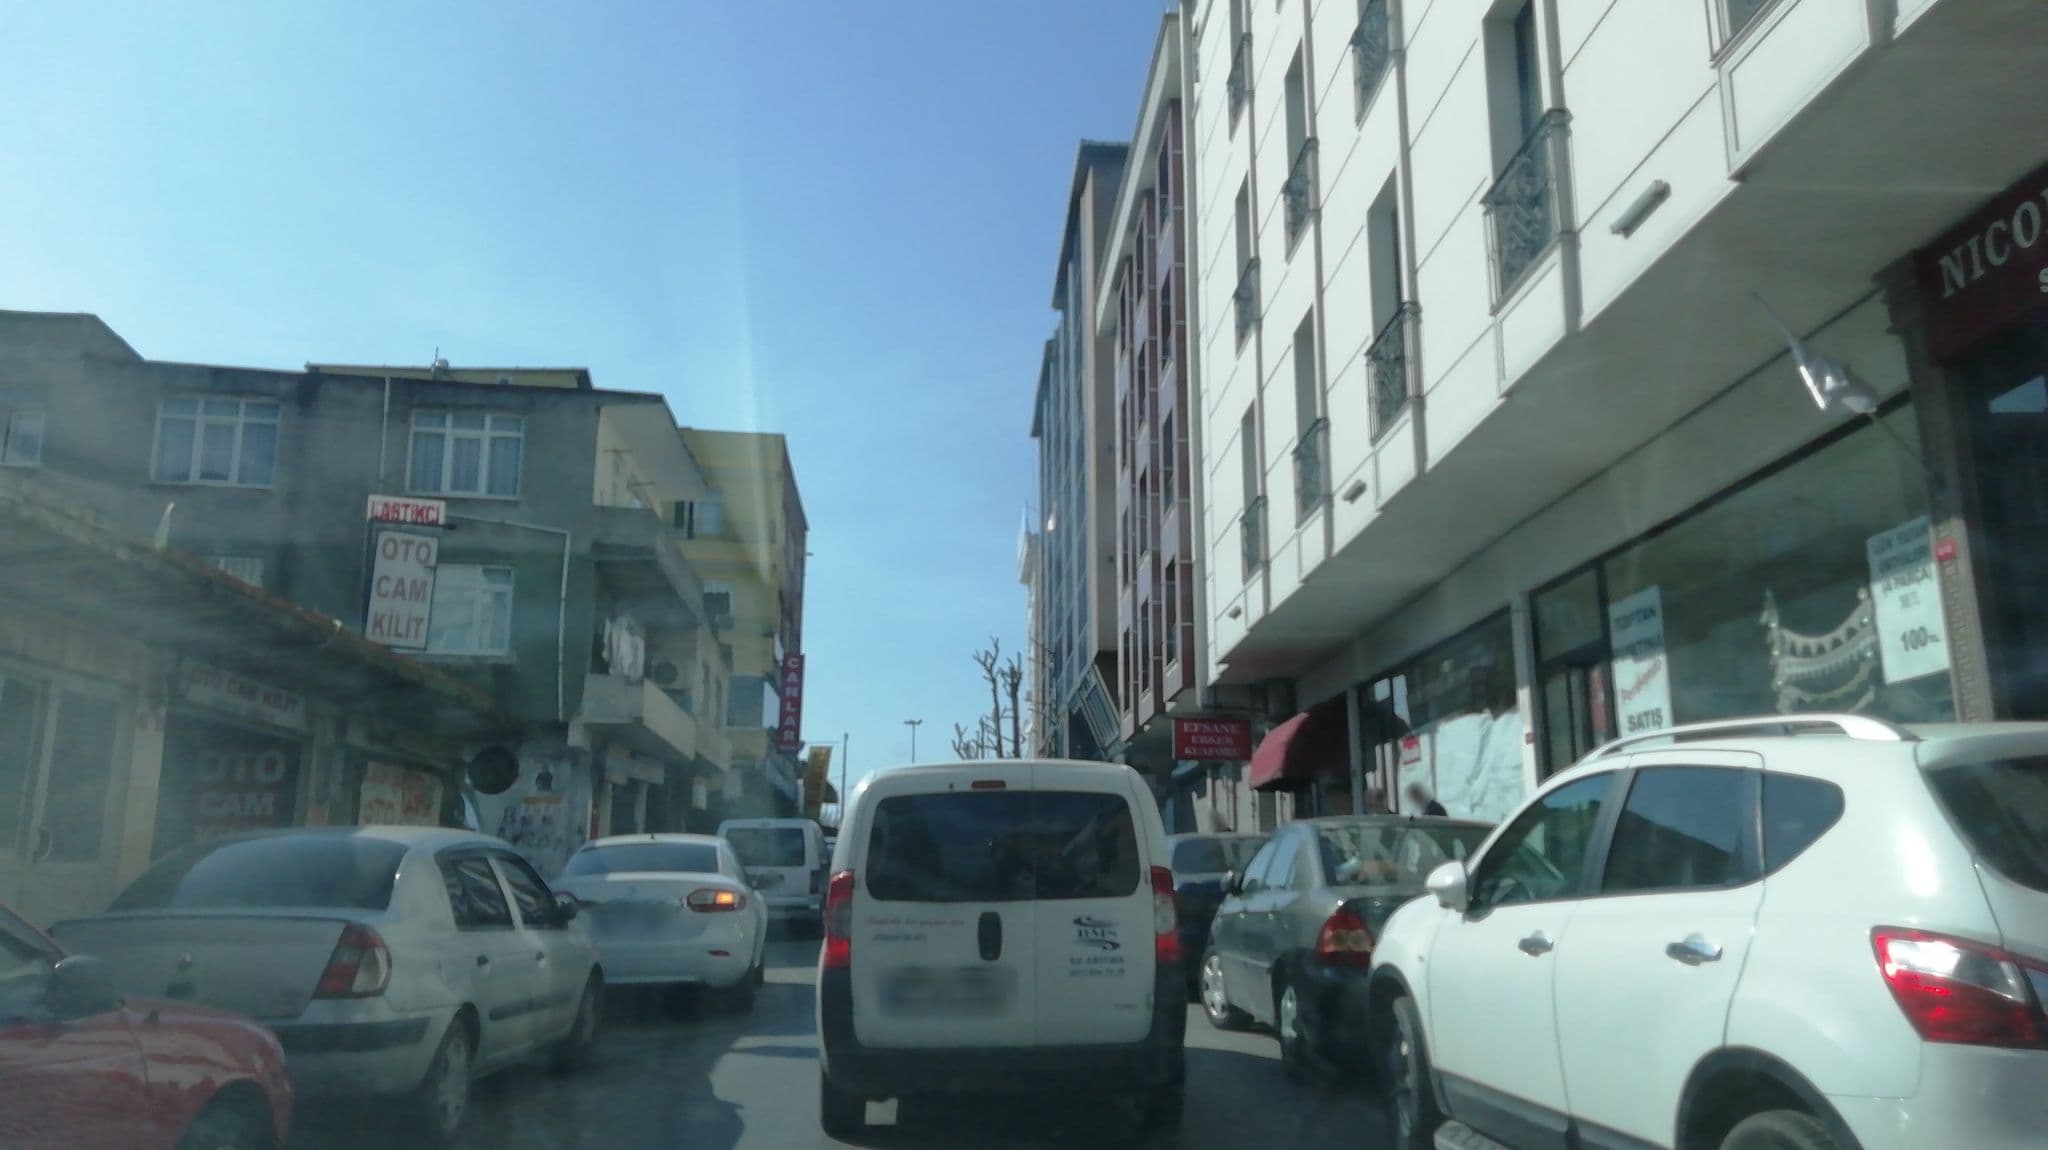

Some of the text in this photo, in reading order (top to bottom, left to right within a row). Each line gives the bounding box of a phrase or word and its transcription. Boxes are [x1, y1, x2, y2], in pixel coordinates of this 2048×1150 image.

[1938, 188, 2048, 299] NICO
[381, 537, 432, 566] OTO
[376, 575, 428, 602] CAM
[782, 656, 800, 743] CANLAR
[1183, 722, 1241, 734] EFSANE
[1627, 707, 1664, 733] SATIŞ
[196, 749, 286, 783] OTO
